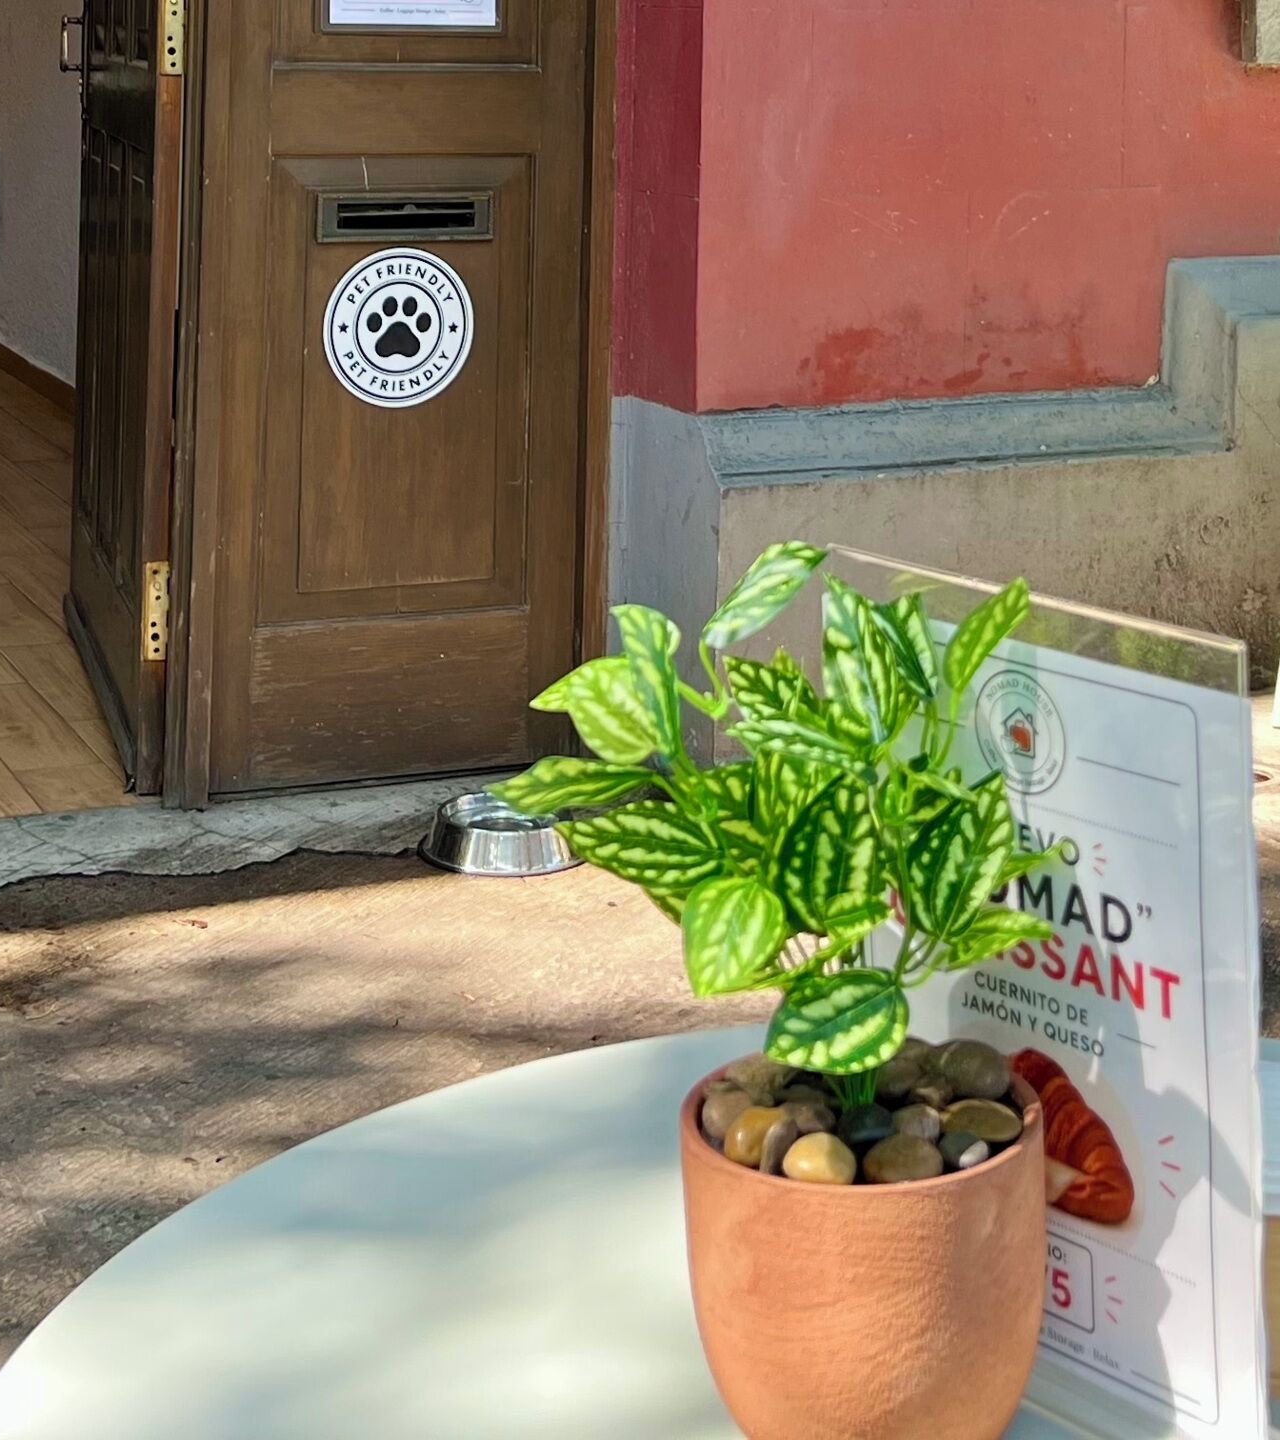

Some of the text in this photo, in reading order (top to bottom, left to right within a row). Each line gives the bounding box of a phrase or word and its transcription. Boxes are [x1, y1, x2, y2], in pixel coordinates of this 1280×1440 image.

[347, 263, 453, 304] PET FRIENDLY
[343, 350, 449, 391] PET FRIENDLY
[974, 970, 1089, 1026] CUERNITO DE
[995, 933, 1180, 1020] SSANT
[961, 992, 1105, 1057] JAMÓN Y QUESO
